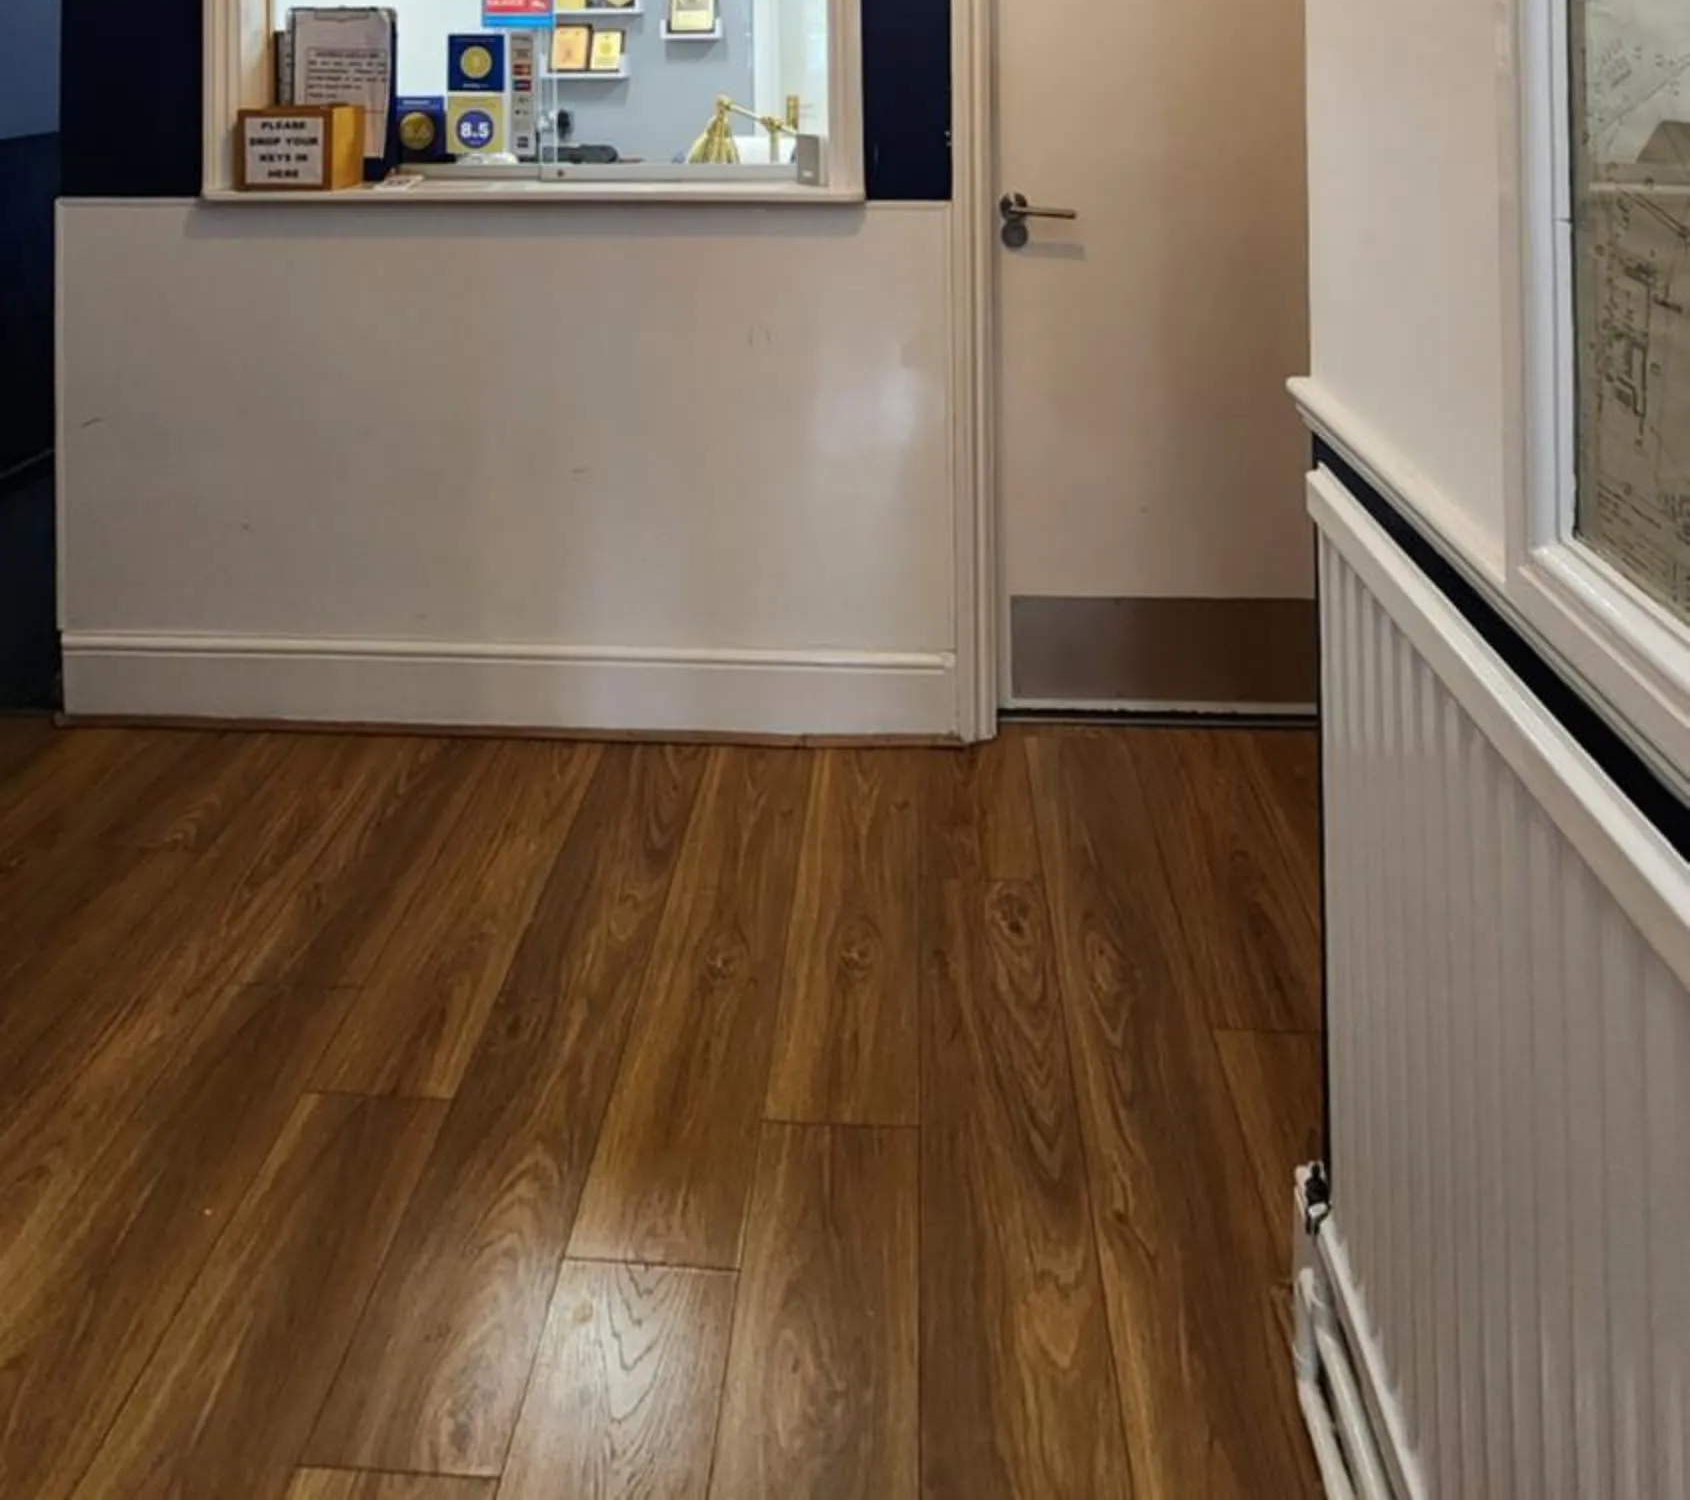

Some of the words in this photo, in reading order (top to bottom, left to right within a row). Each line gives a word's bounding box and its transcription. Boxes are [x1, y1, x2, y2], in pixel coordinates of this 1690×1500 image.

[261, 121, 306, 131] PLEASE
[460, 121, 489, 139] 8.5
[249, 137, 280, 147] DROP
[285, 137, 318, 146] YOUR
[259, 153, 291, 162] KEYS
[295, 153, 308, 162] IN
[267, 169, 299, 179] HERE
